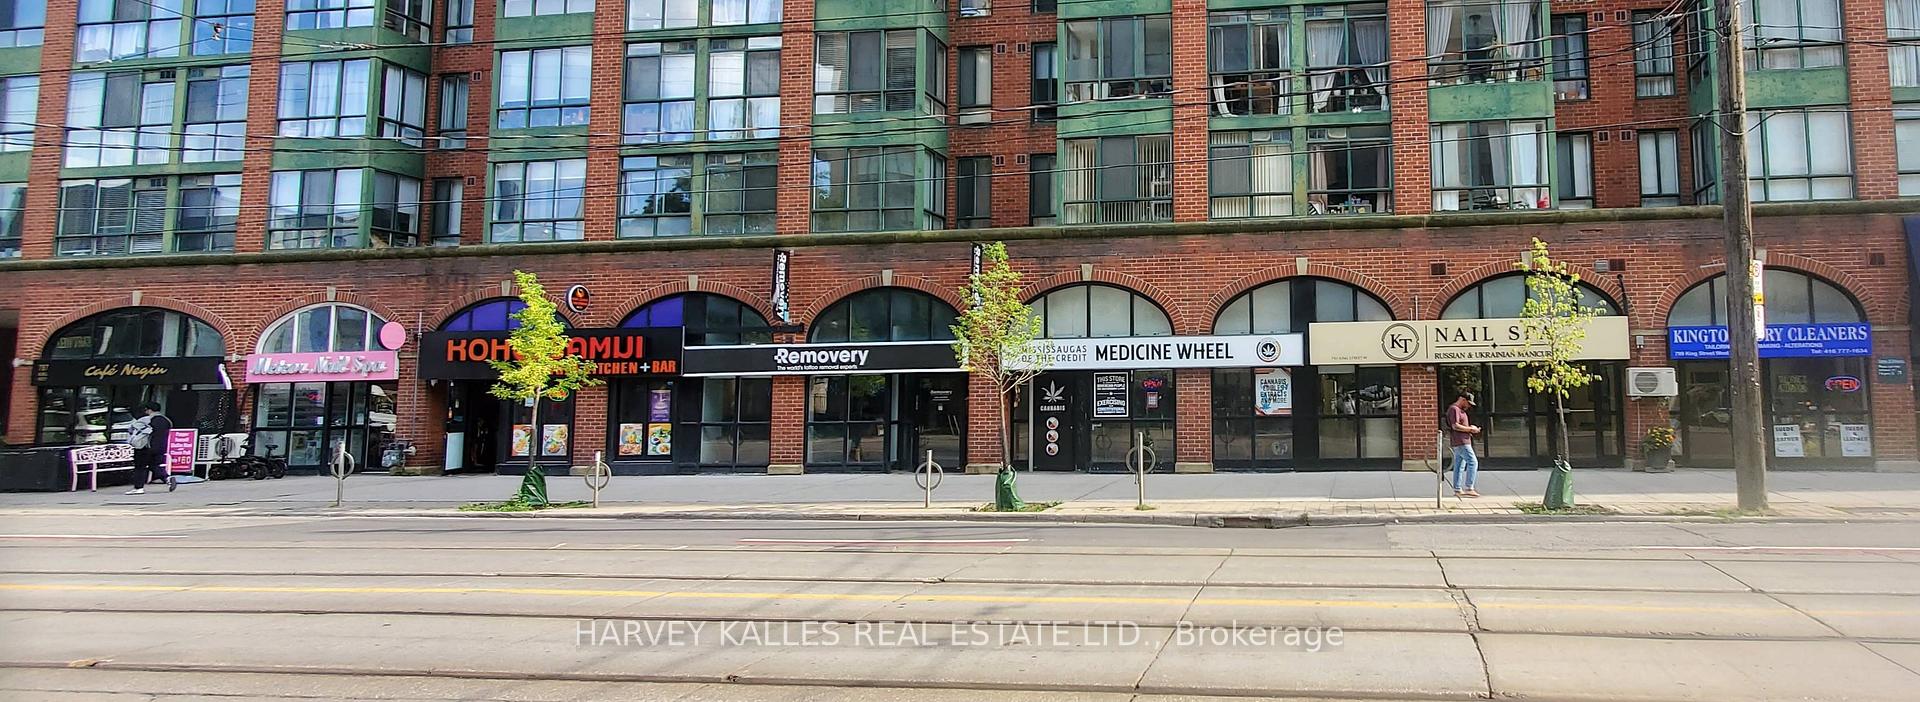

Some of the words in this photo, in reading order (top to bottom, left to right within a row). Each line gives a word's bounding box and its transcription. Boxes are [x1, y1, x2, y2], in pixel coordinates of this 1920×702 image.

[776, 252, 787, 319] Removery
[1435, 326, 1494, 342] NAIL
[1673, 328, 1729, 344] KINGTO
[1787, 325, 1868, 341] CLEANERS
[446, 338, 511, 361] KOH
[550, 335, 643, 360] AMUI
[1095, 343, 1172, 361] MEDICINE
[1176, 342, 1234, 360] WHEEL
[1390, 333, 1413, 354] KT
[773, 347, 870, 366] Removery
[1056, 353, 1087, 362] CREDIT
[1434, 352, 1466, 360] RUSSIAN
[1475, 351, 1516, 359] UKRAINIAN
[1517, 350, 1552, 358] MANICUR
[84, 364, 119, 379] Café
[120, 363, 168, 379] Negin
[652, 360, 677, 373] BAR
[1828, 379, 1858, 389] OPEN
